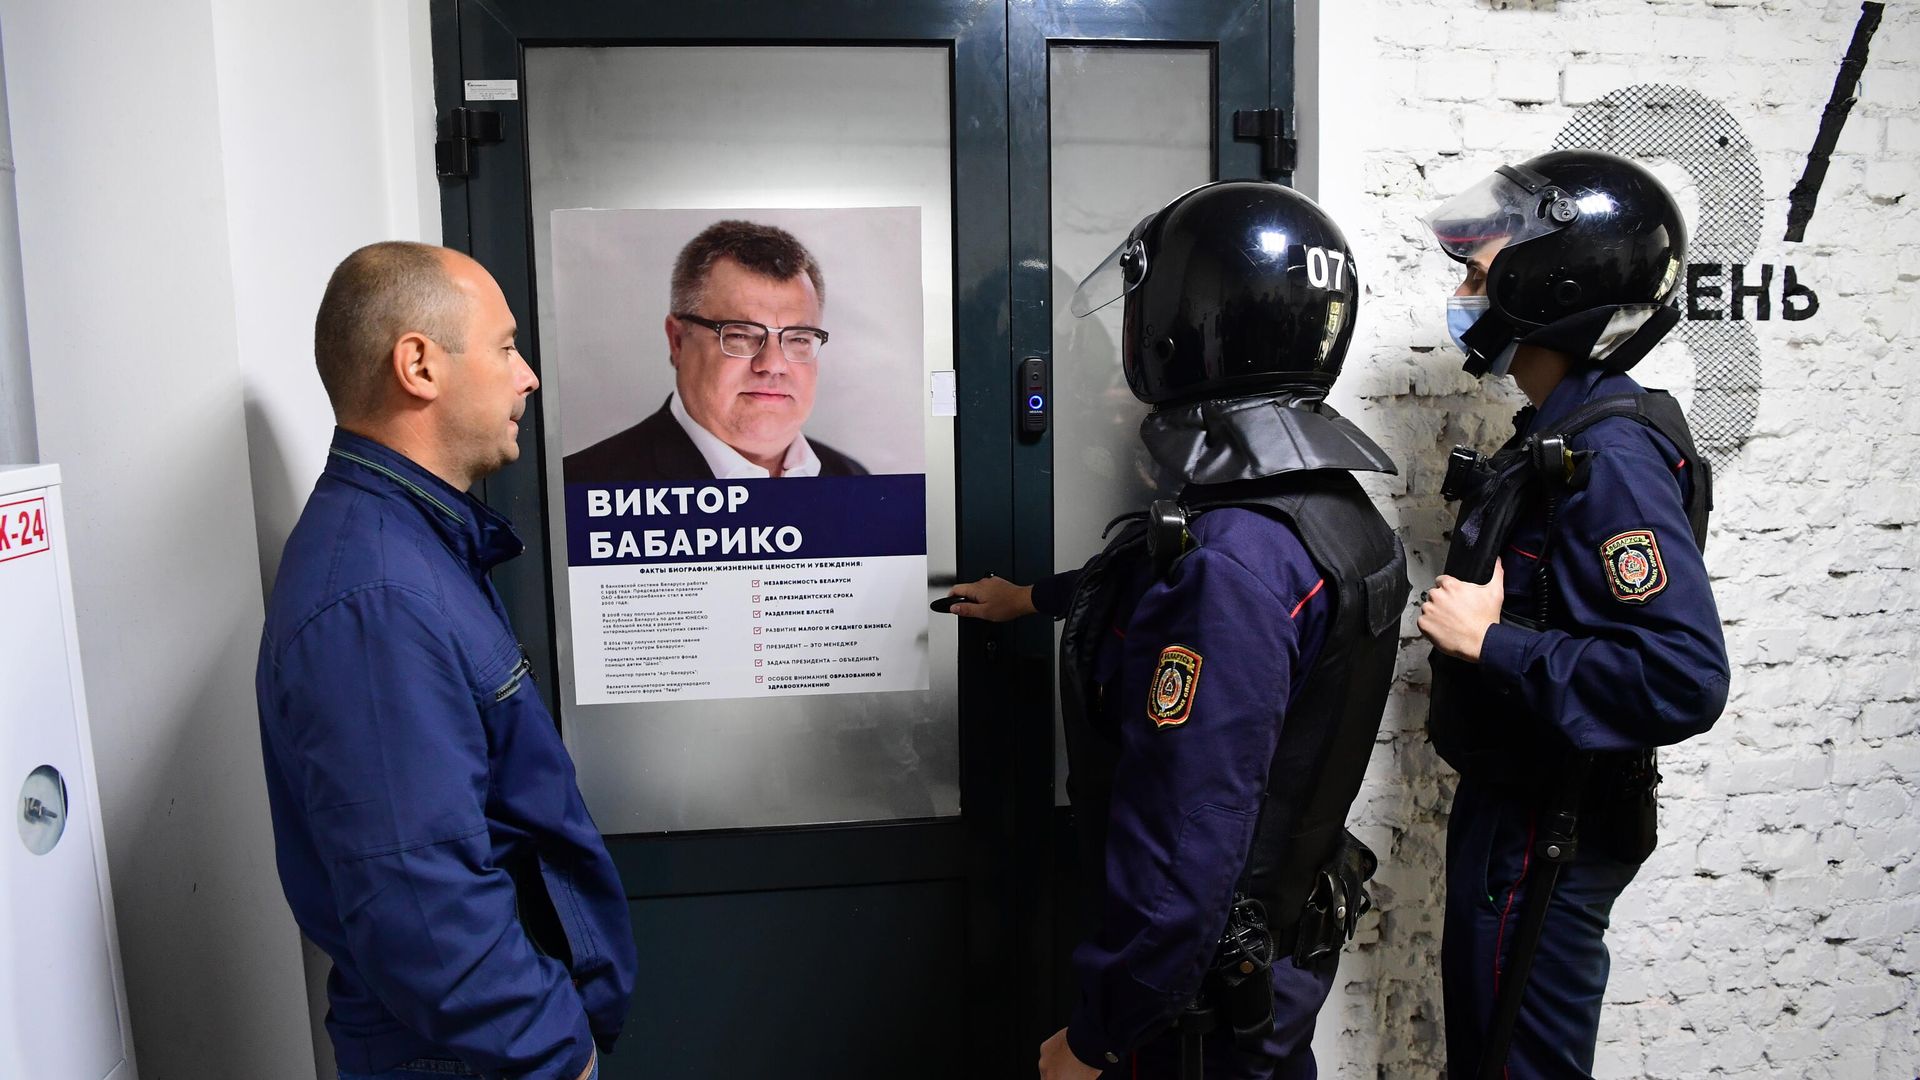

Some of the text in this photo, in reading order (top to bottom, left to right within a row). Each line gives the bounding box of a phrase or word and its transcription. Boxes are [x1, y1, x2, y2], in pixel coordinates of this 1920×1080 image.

[1306, 247, 1344, 290] 07
[1675, 264, 1820, 321] ЕНЬ
[588, 486, 749, 517] ВИКТОР
[590, 526, 802, 558] БАБАРИКО
